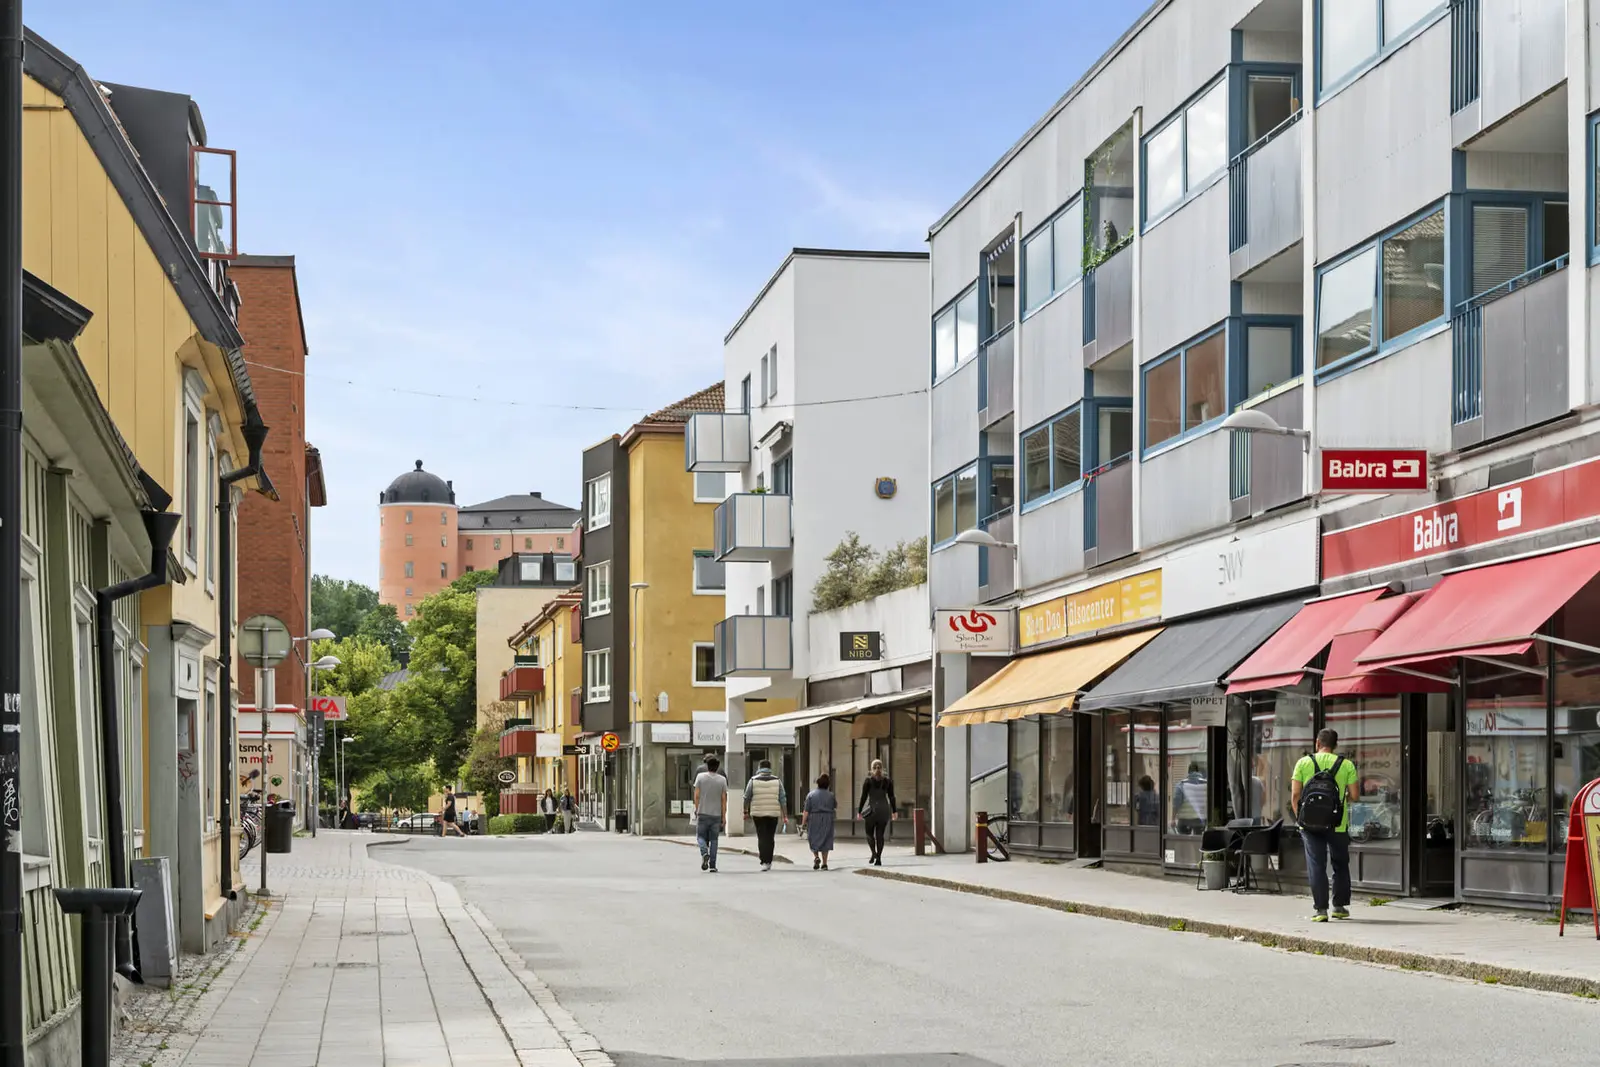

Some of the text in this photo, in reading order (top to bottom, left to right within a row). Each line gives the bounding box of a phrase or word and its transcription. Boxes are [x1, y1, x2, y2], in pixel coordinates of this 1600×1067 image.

[1329, 459, 1387, 478] Babra
[1413, 510, 1459, 552] Babra
[1045, 609, 1061, 632] Dao
[849, 650, 873, 658] NIBO
[312, 698, 339, 713] ICA
